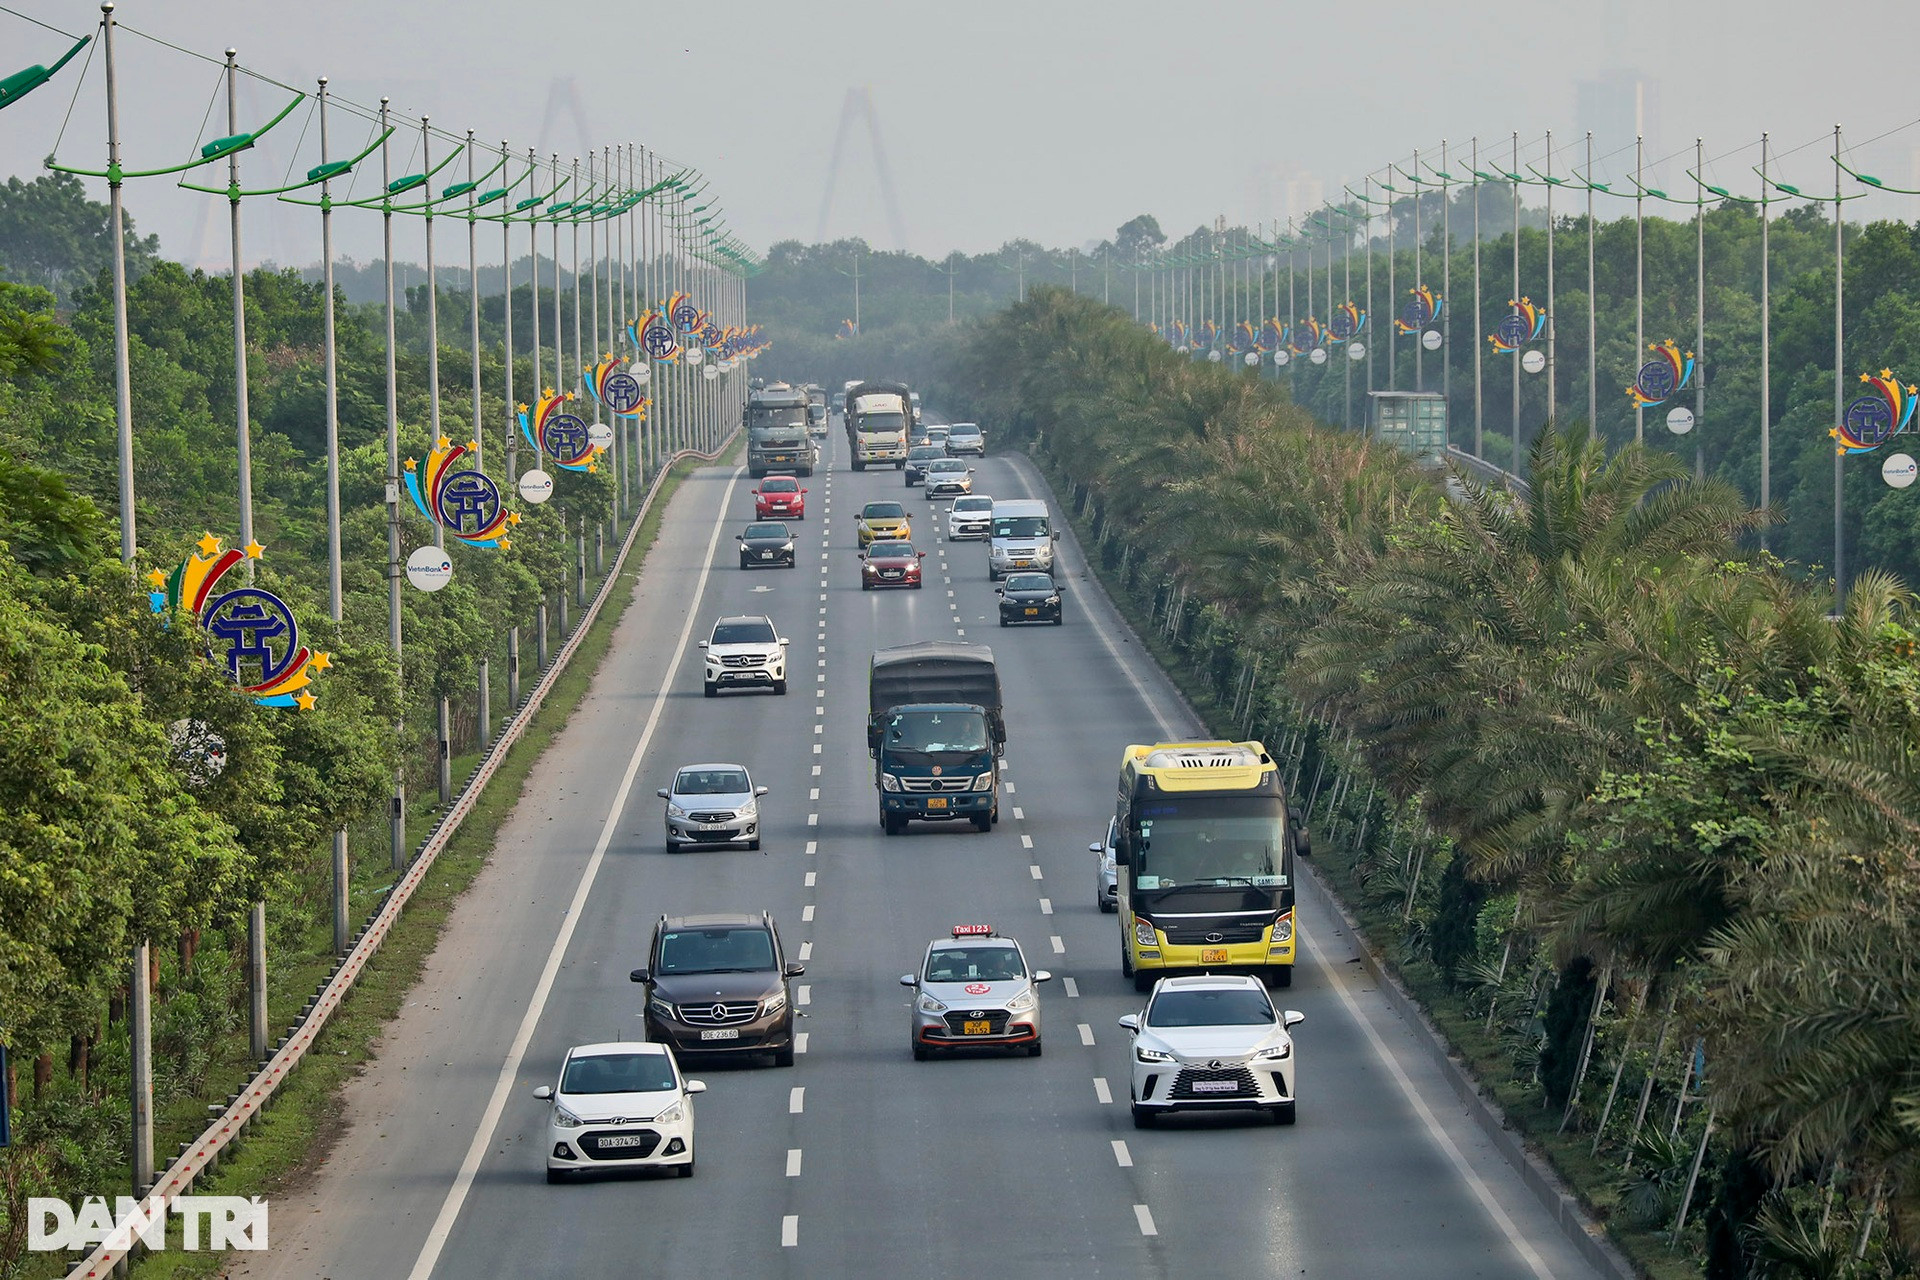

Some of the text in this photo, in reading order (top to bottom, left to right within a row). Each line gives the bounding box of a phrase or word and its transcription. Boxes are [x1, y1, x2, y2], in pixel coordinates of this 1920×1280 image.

[1257, 878, 1285, 886] SAMSG
[954, 924, 989, 933] Taxi 123
